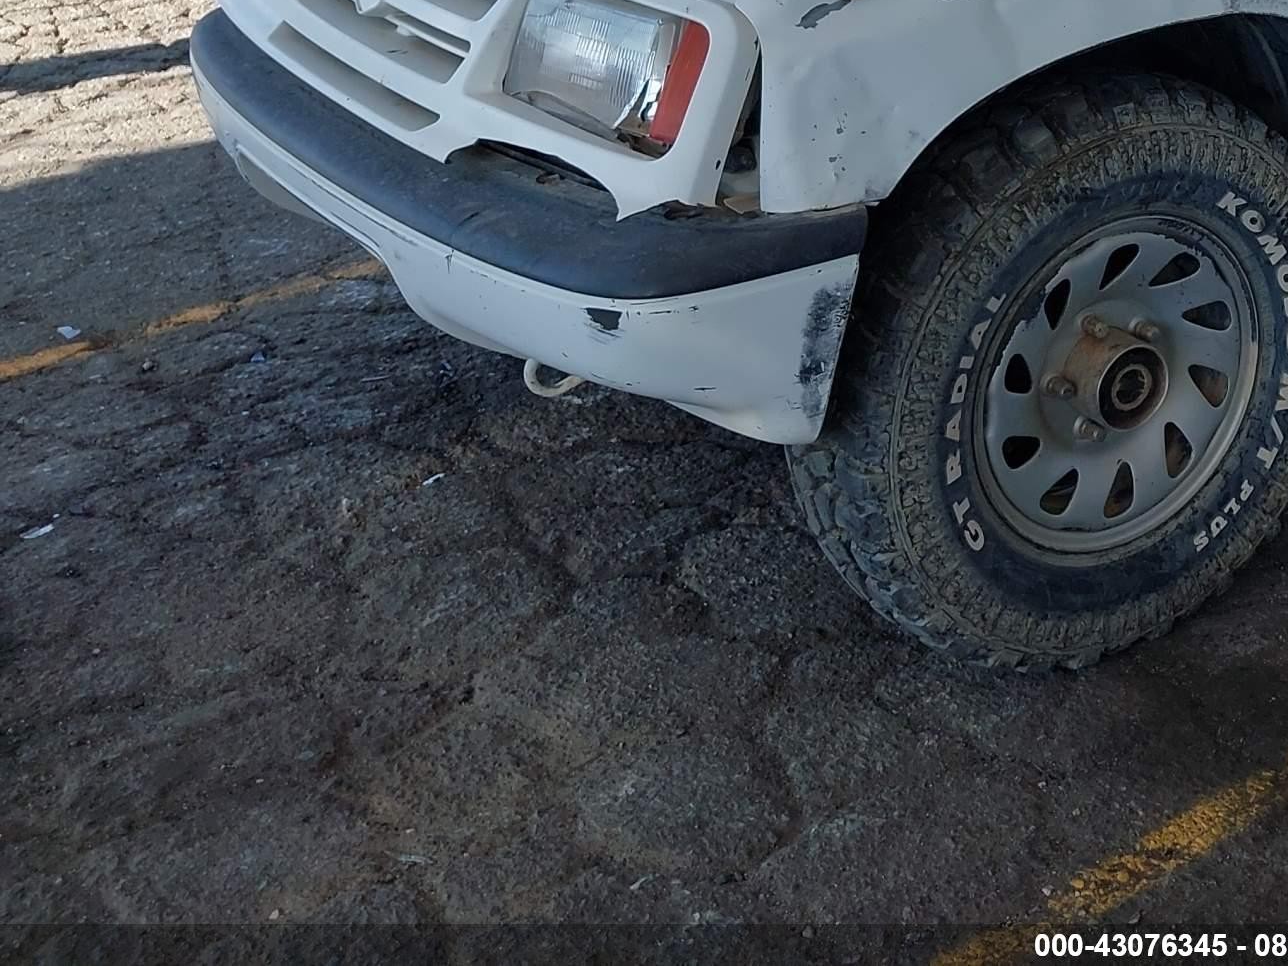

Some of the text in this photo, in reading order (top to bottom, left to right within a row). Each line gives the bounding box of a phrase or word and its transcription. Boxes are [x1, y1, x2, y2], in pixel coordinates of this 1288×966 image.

[944, 293, 1007, 551] GT RADIAL
[1193, 479, 1255, 552] PLUS
